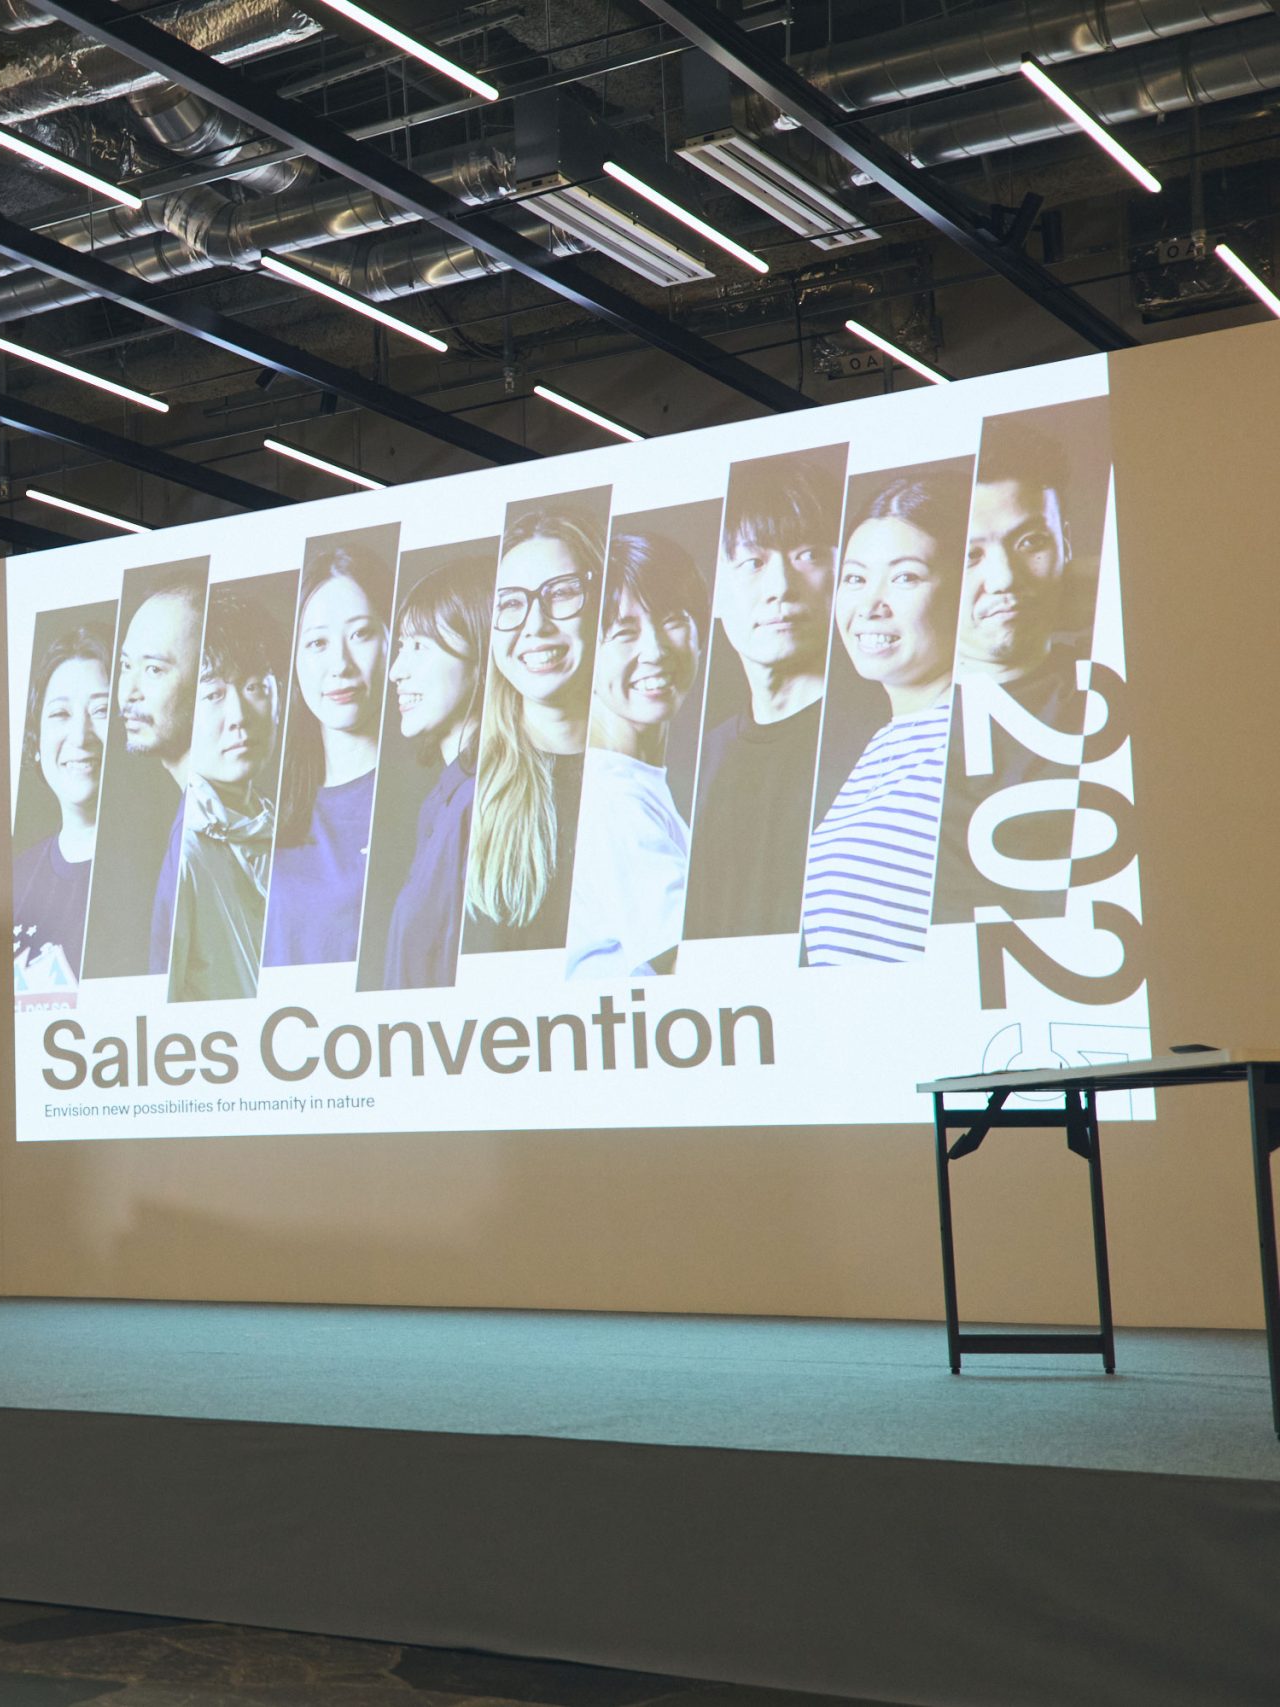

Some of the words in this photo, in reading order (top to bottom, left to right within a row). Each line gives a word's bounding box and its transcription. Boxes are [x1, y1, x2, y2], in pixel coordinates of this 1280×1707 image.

[849, 355, 878, 370] OA
[42, 1015, 240, 1091] Sales
[260, 988, 776, 1082] Convention
[44, 1103, 99, 1118] Envision
[102, 1104, 130, 1116] new
[133, 1099, 213, 1118] possibilities
[217, 1098, 236, 1113] for
[239, 1096, 307, 1113] humanity
[310, 1095, 323, 1110] in
[327, 1095, 375, 1109] nature
